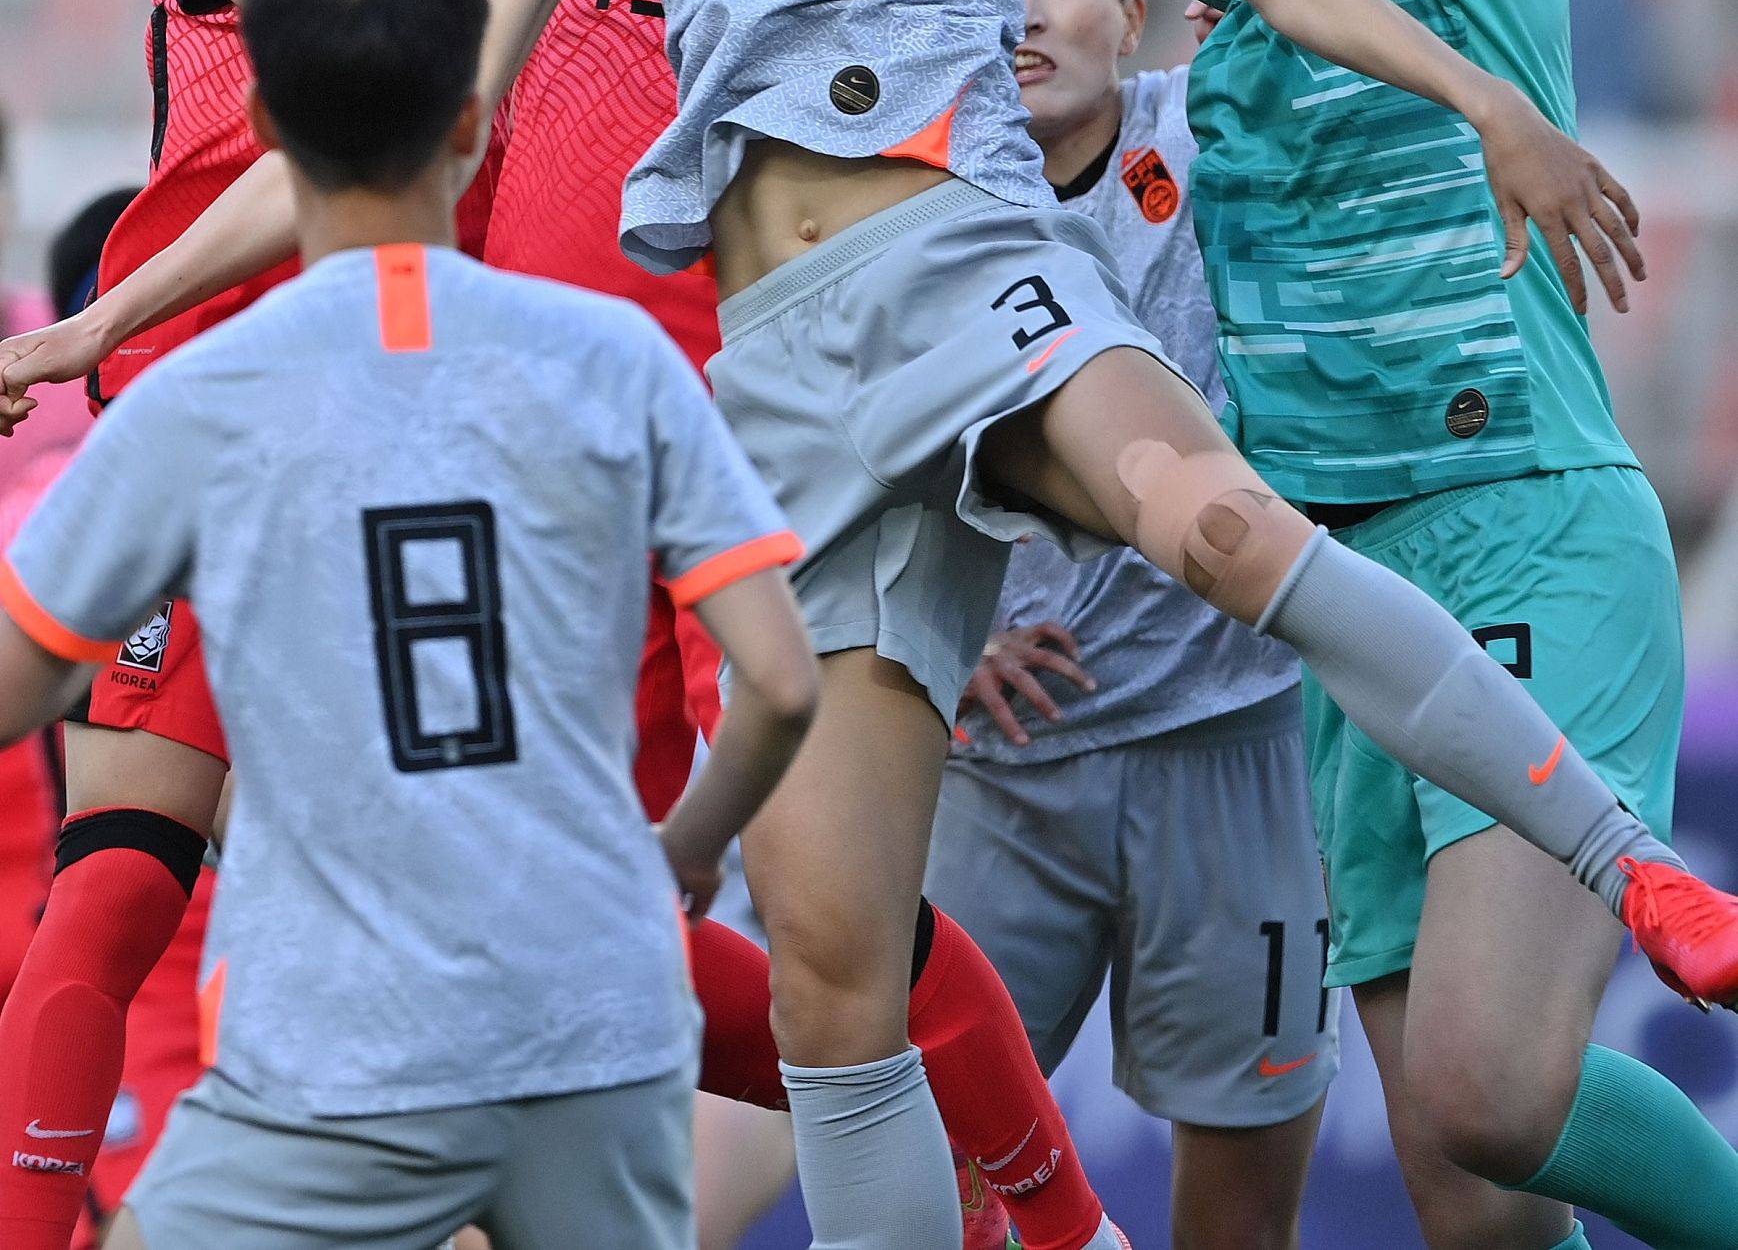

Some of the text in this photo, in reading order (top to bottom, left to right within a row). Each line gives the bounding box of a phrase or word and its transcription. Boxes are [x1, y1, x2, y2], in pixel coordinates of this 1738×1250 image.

[991, 275, 1072, 351] 3
[361, 501, 518, 772] 8
[111, 671, 157, 692] KOREA
